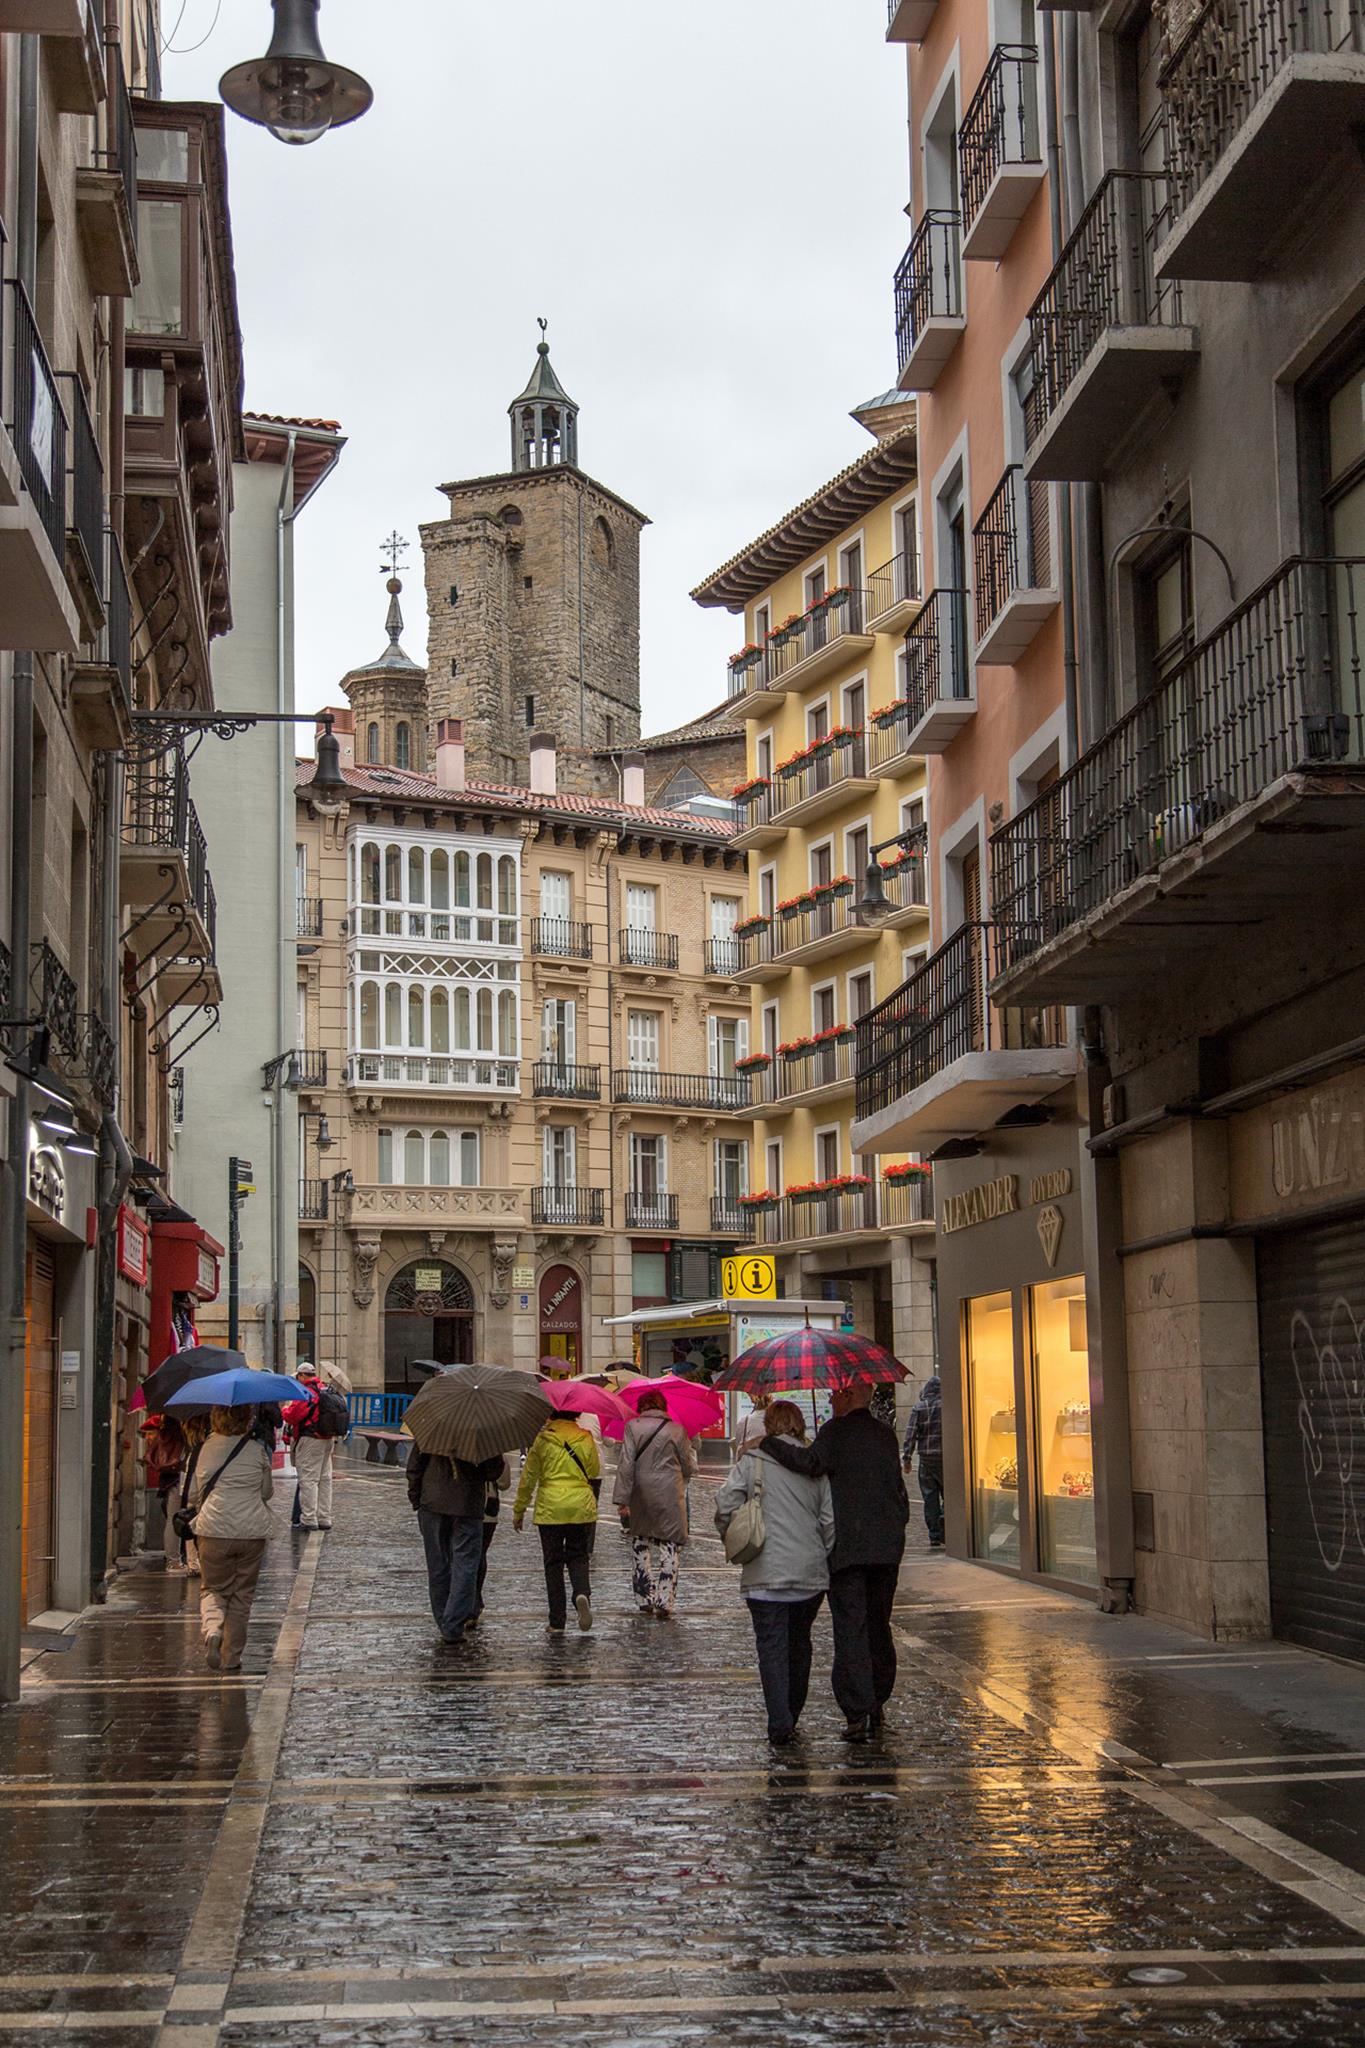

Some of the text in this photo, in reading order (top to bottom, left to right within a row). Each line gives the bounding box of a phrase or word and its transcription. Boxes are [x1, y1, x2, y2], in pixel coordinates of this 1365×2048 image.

[941, 1168, 1071, 1235] ALEXANDER JOYERO
[543, 1276, 577, 1316] LA INFANTIL
[541, 1320, 578, 1329] CALZADOS
